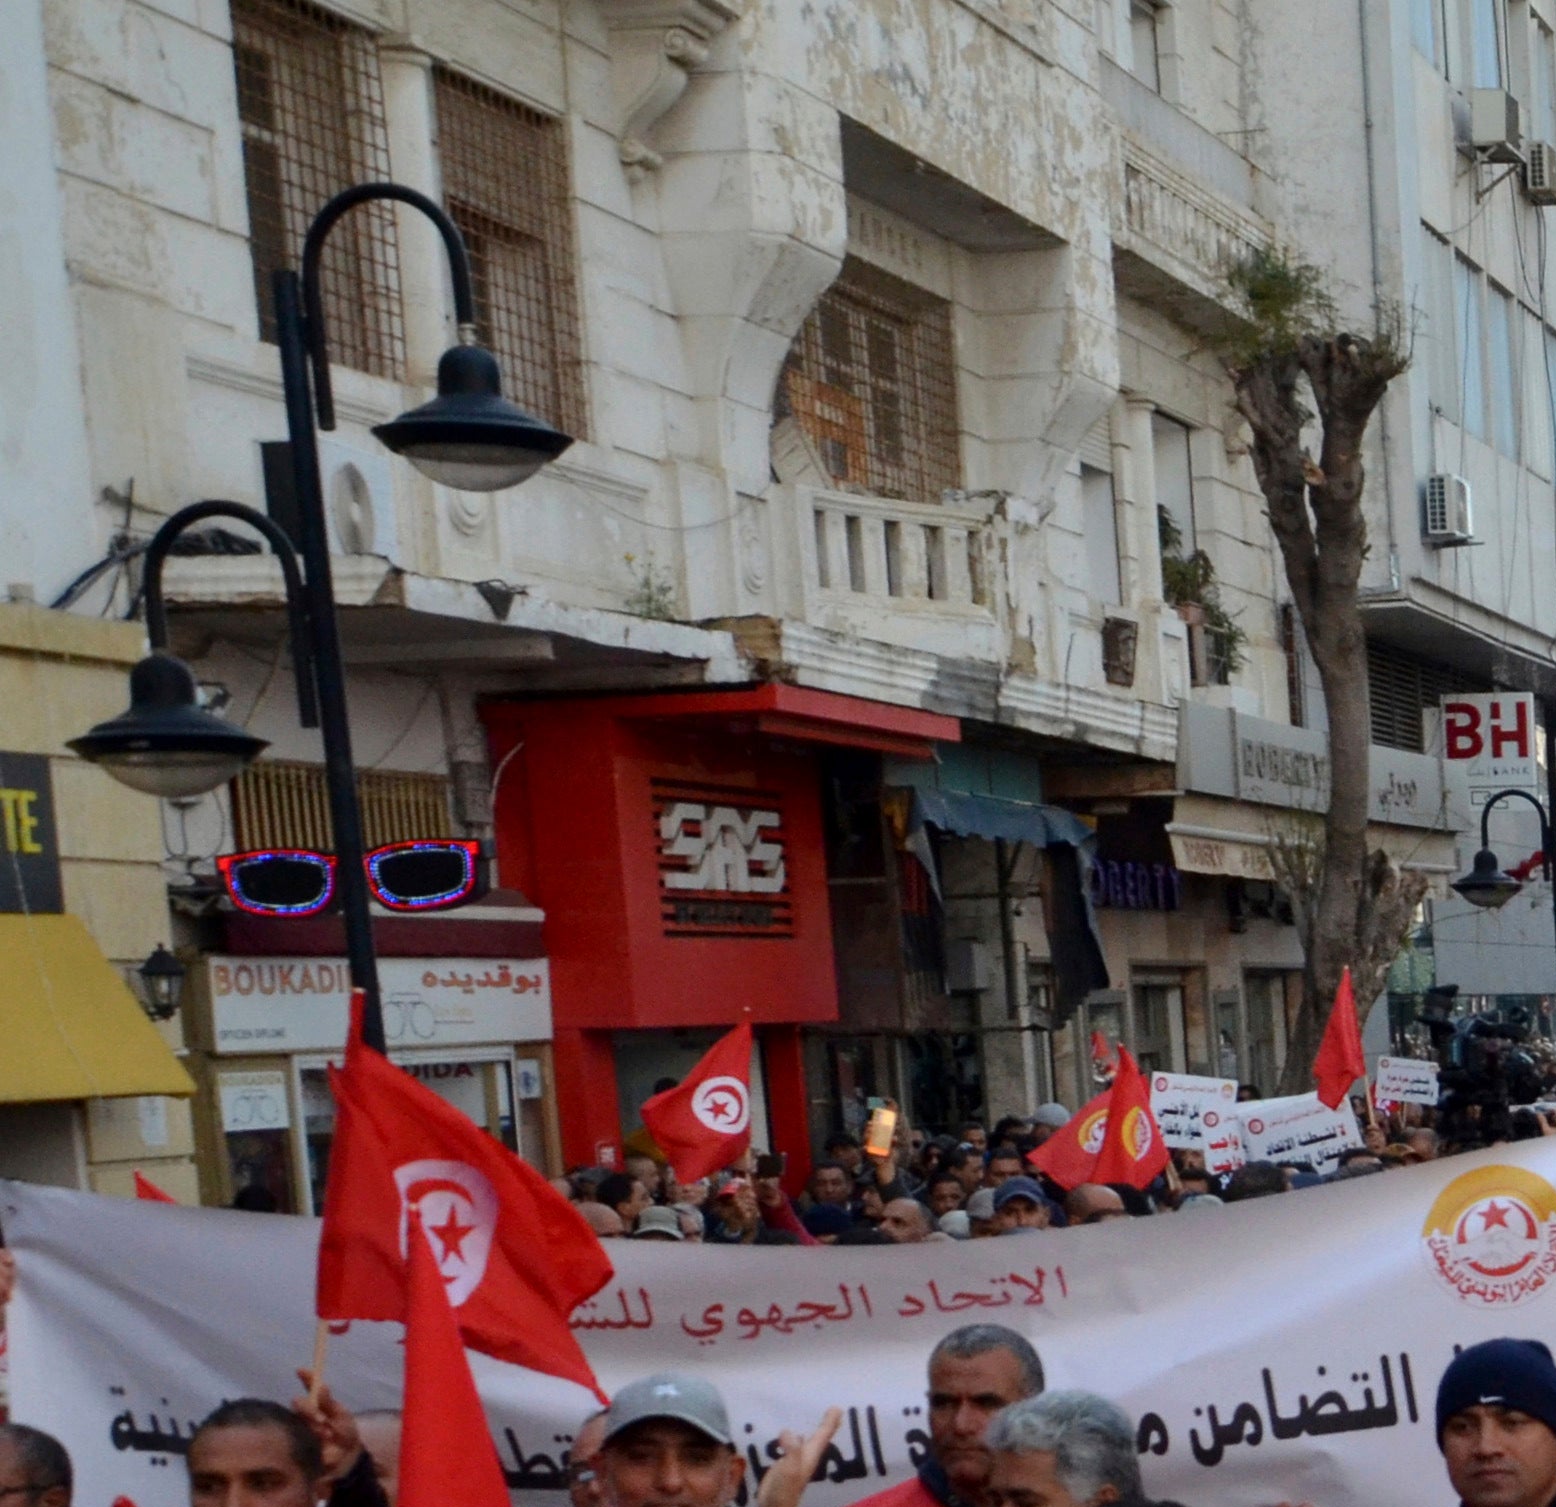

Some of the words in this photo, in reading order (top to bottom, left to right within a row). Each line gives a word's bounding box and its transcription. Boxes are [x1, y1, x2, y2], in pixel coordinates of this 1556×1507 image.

[1445, 702, 1529, 759] BH
[659, 802, 786, 893] SAS
[213, 963, 352, 996] BOUKADI
[679, 1283, 873, 1346] الجهوي
[898, 1265, 1069, 1319] الاتحاد
[1190, 1352, 1419, 1468] التضامن
